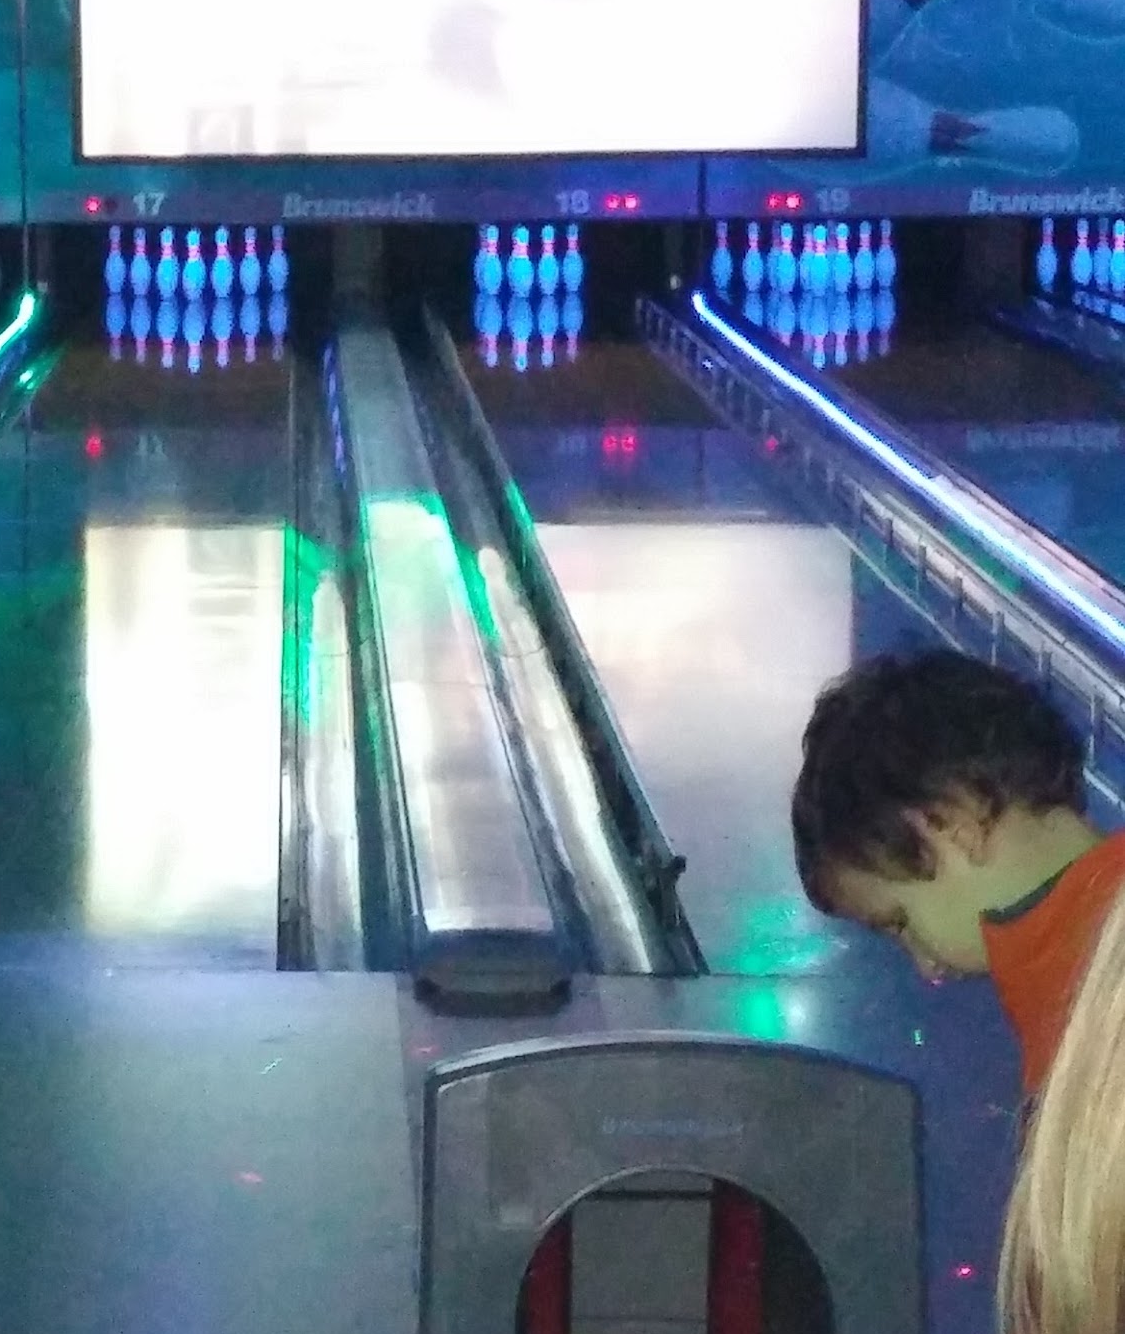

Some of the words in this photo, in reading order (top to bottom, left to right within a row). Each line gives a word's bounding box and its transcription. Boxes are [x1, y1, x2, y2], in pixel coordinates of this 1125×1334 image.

[132, 191, 166, 215] 17
[281, 191, 435, 217] Brunswick
[556, 189, 590, 214] 18
[815, 187, 851, 213] 19
